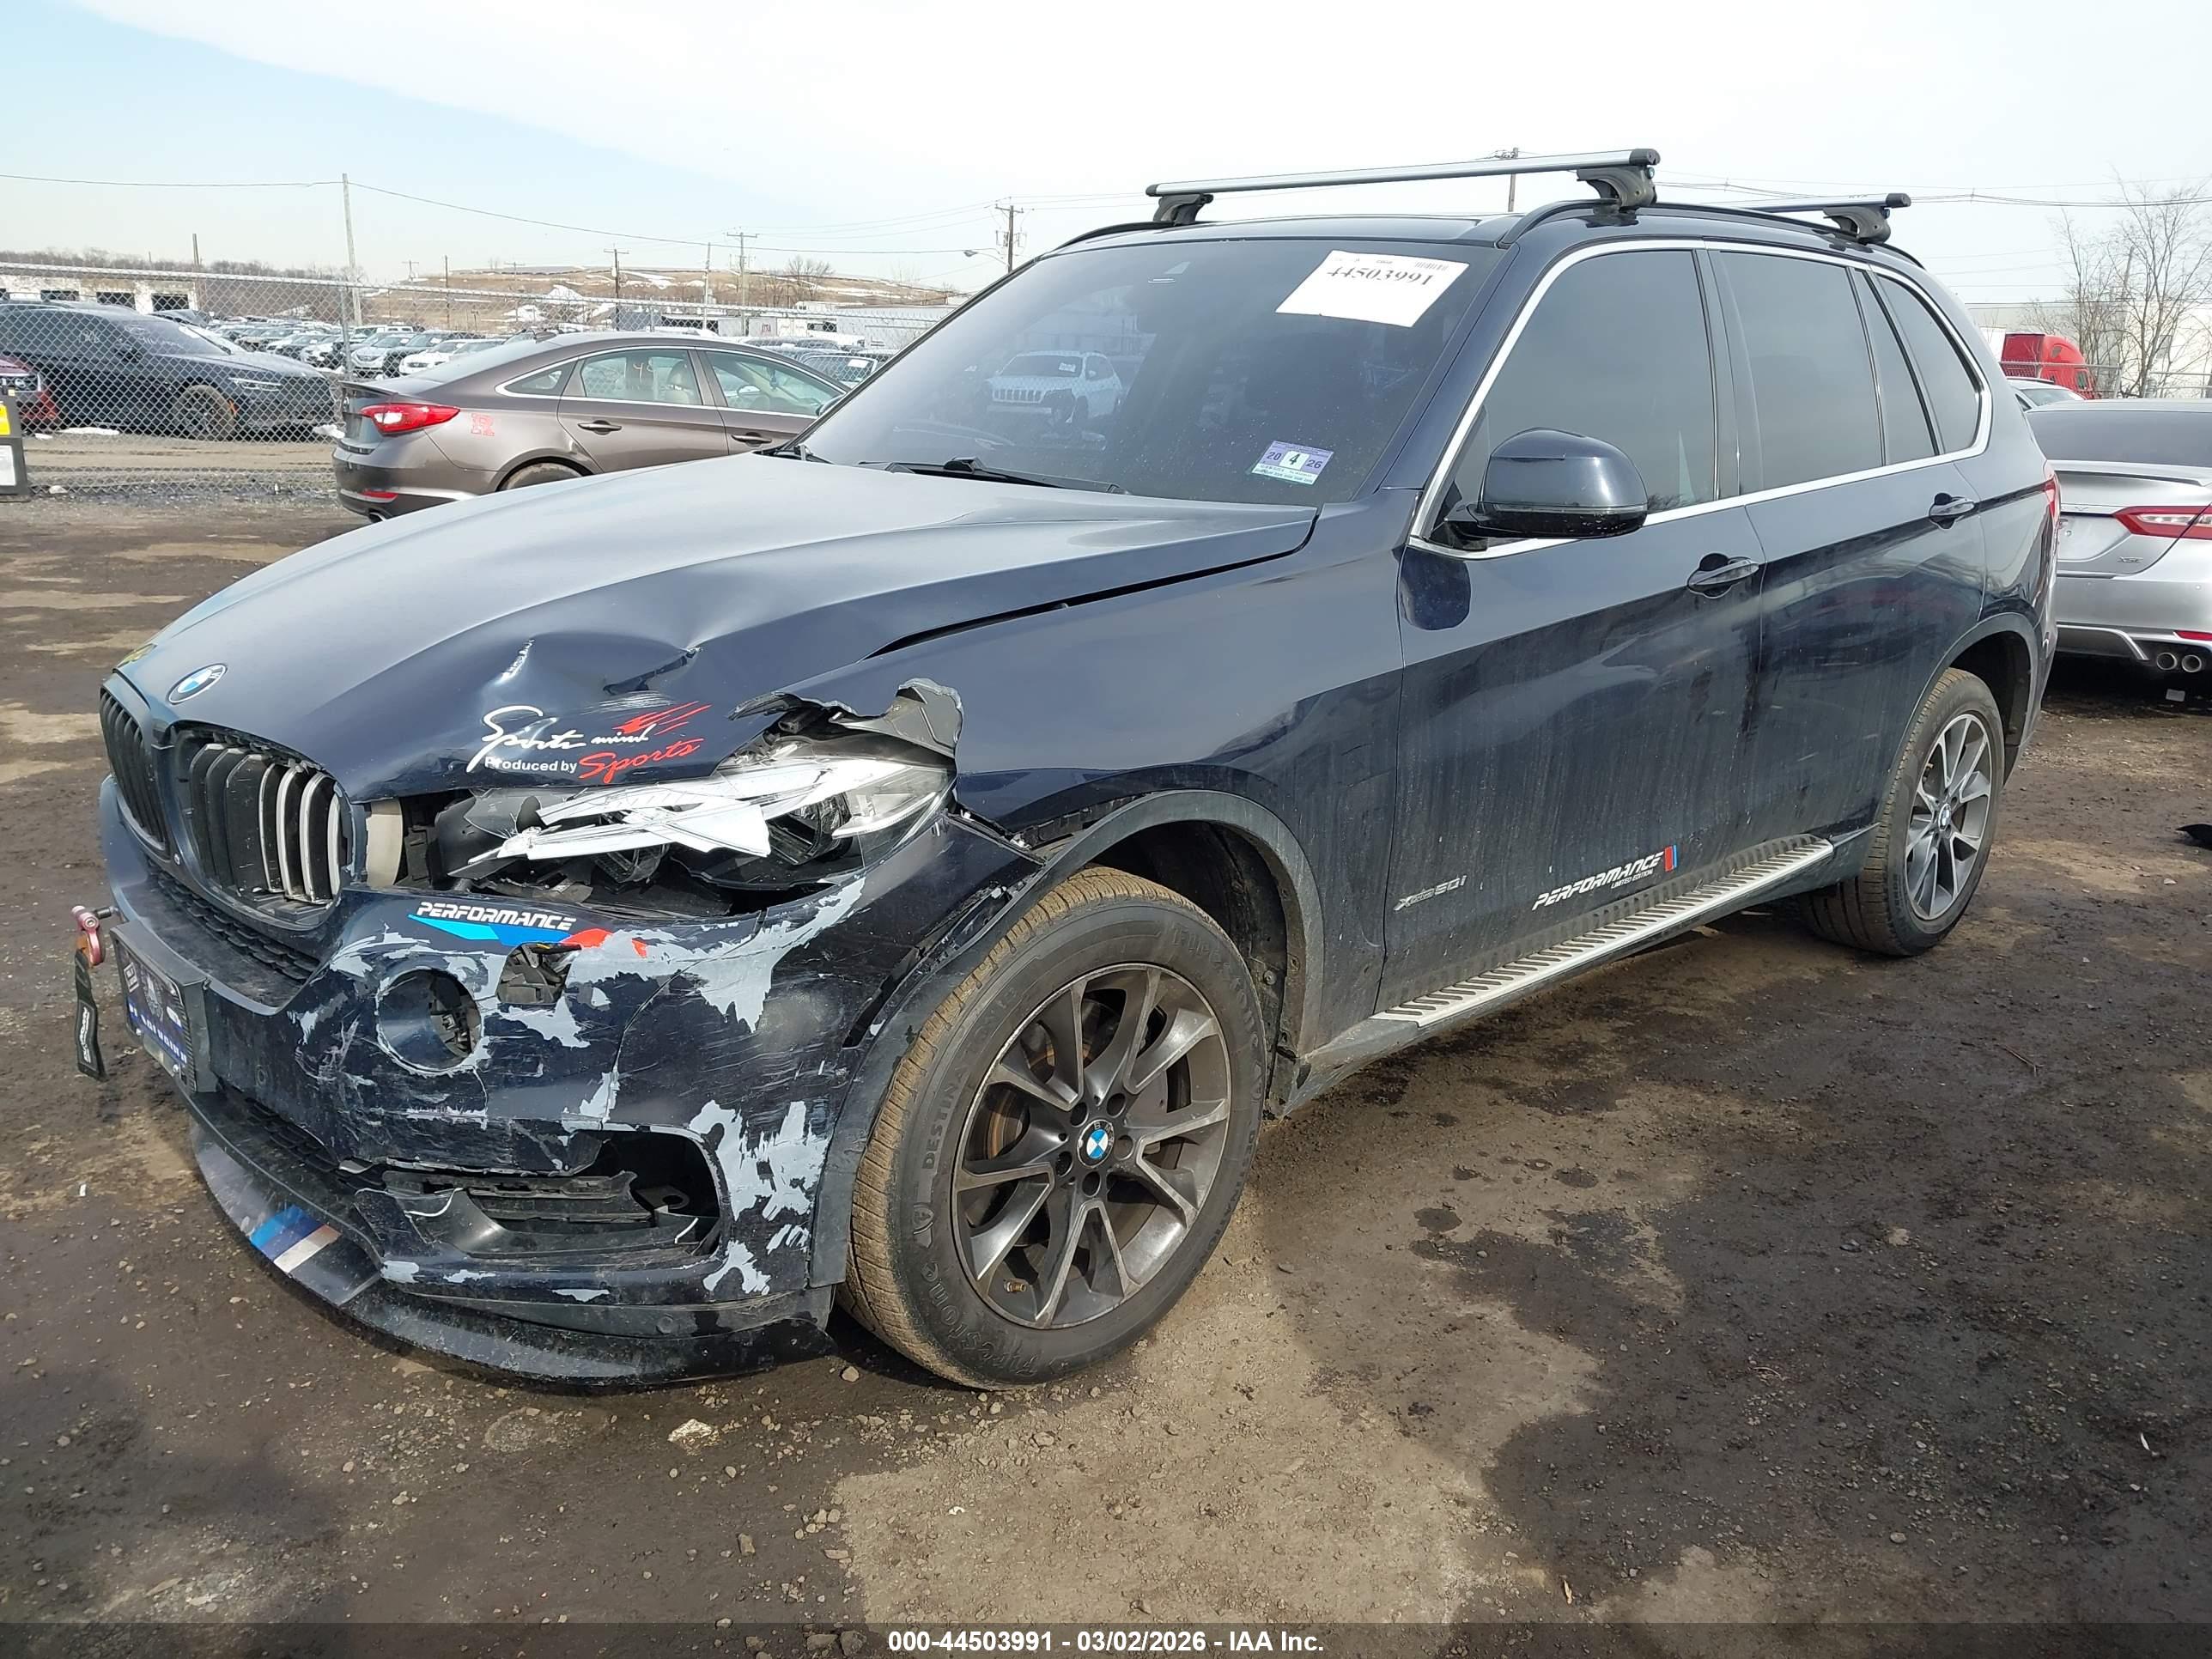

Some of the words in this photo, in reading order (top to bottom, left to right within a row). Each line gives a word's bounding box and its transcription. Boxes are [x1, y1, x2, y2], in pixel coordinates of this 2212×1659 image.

[1328, 267, 1434, 286] 44503991
[1267, 452, 1282, 461] 20
[1289, 453, 1301, 465] 4
[1305, 459, 1321, 469] 26
[591, 723, 657, 744] mind
[484, 756, 557, 771] Produced
[561, 759, 577, 774] by
[579, 738, 705, 783] Sports
[1531, 851, 1664, 911] PERFORMANCE
[1611, 876, 1633, 890] LIMITED
[1632, 868, 1654, 883] EDITION
[416, 901, 577, 931] PERFORMANCE
